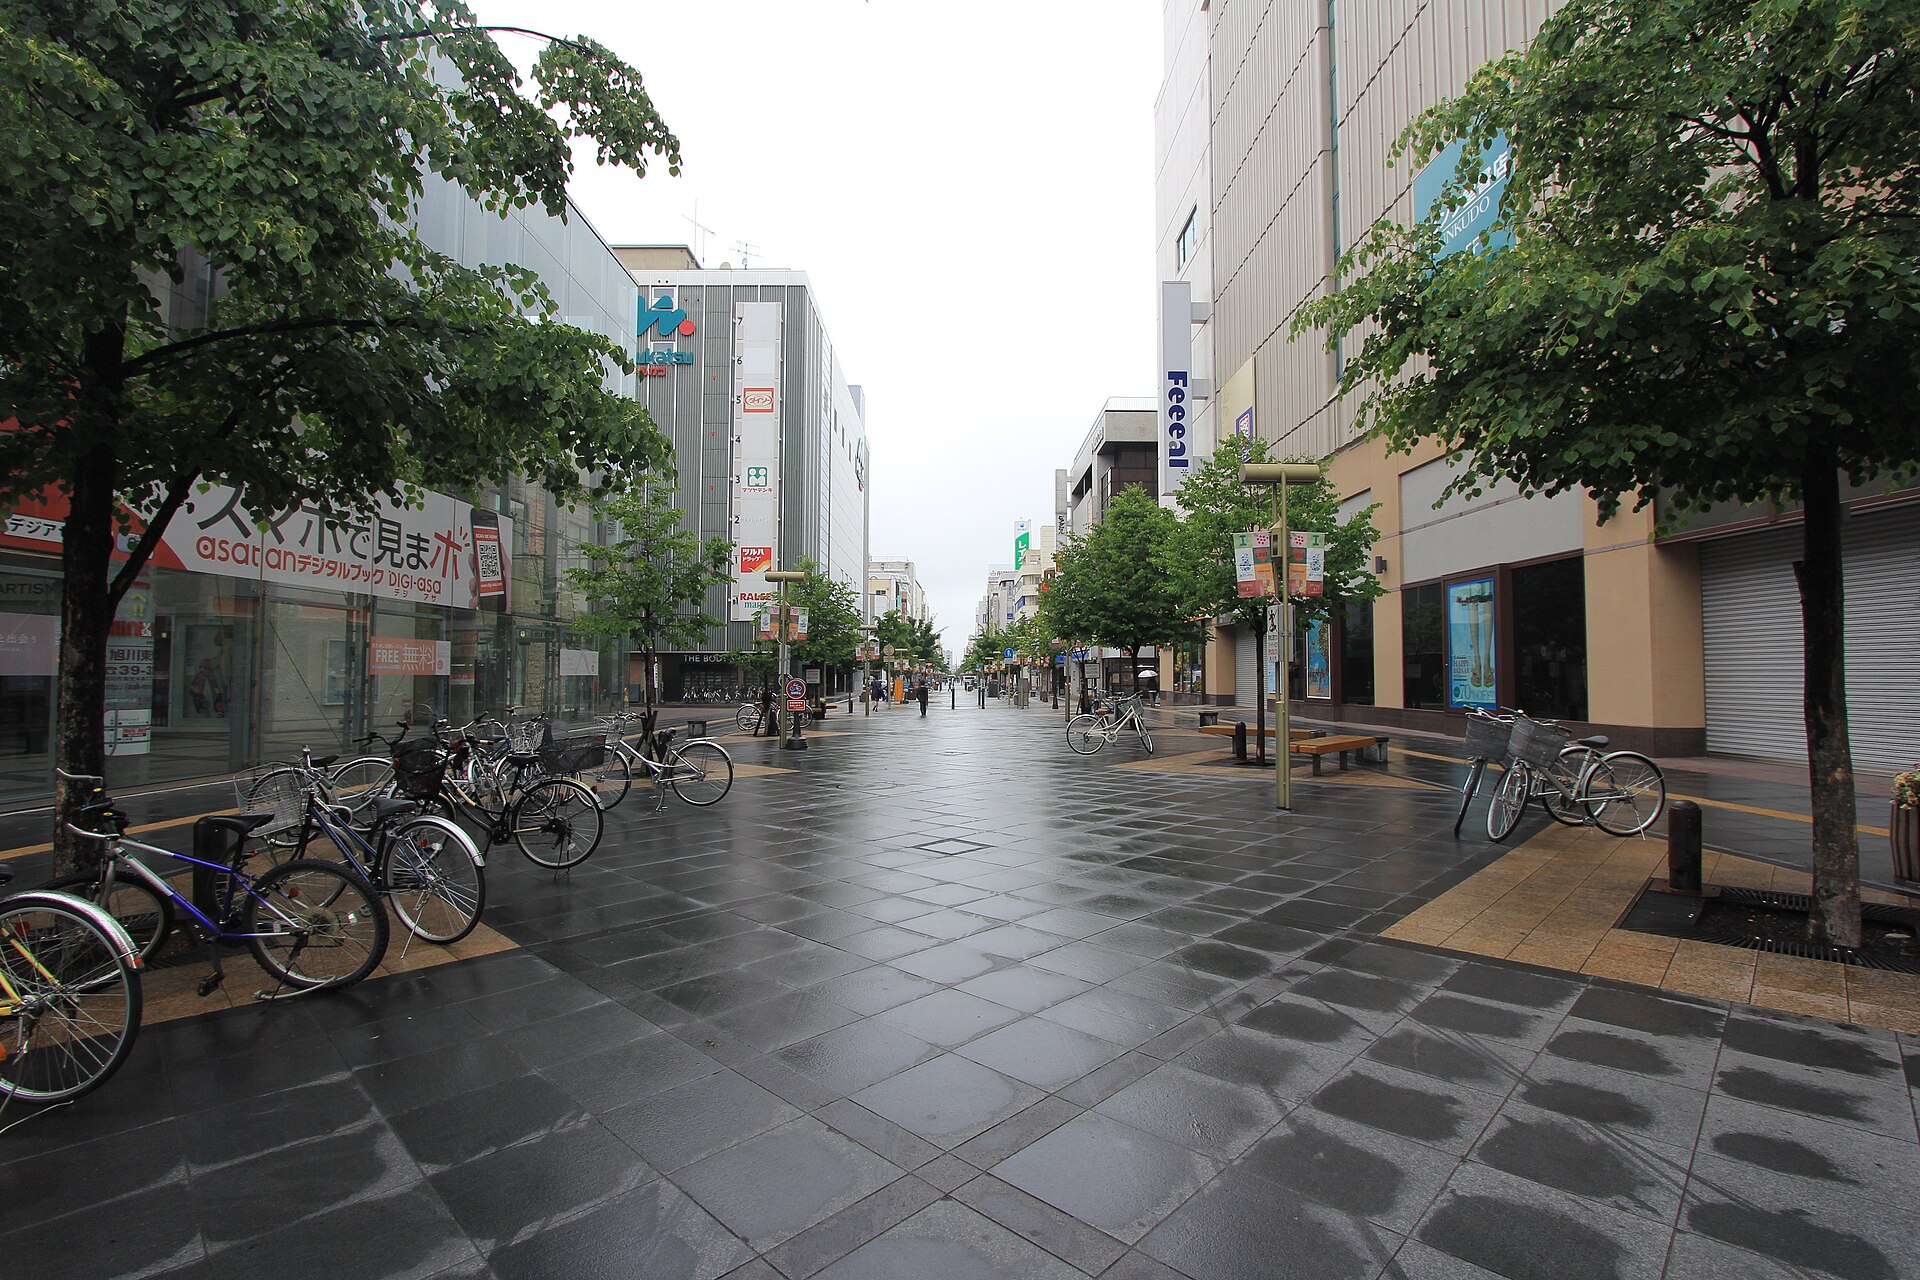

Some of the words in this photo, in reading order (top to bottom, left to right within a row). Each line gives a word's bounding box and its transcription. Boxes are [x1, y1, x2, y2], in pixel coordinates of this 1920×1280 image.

[1443, 195, 1490, 244] NKUDO
[737, 316, 743, 326] 7
[736, 356, 743, 365] 6
[735, 395, 742, 404] 5
[1167, 371, 1189, 467] Feeeal
[734, 435, 742, 444] 4
[734, 475, 741, 484] 3
[734, 515, 740, 524] 2
[742, 548, 765, 556] ツルハ
[375, 649, 399, 663] FREE
[402, 644, 435, 671] 無料
[683, 654, 701, 662] THE
